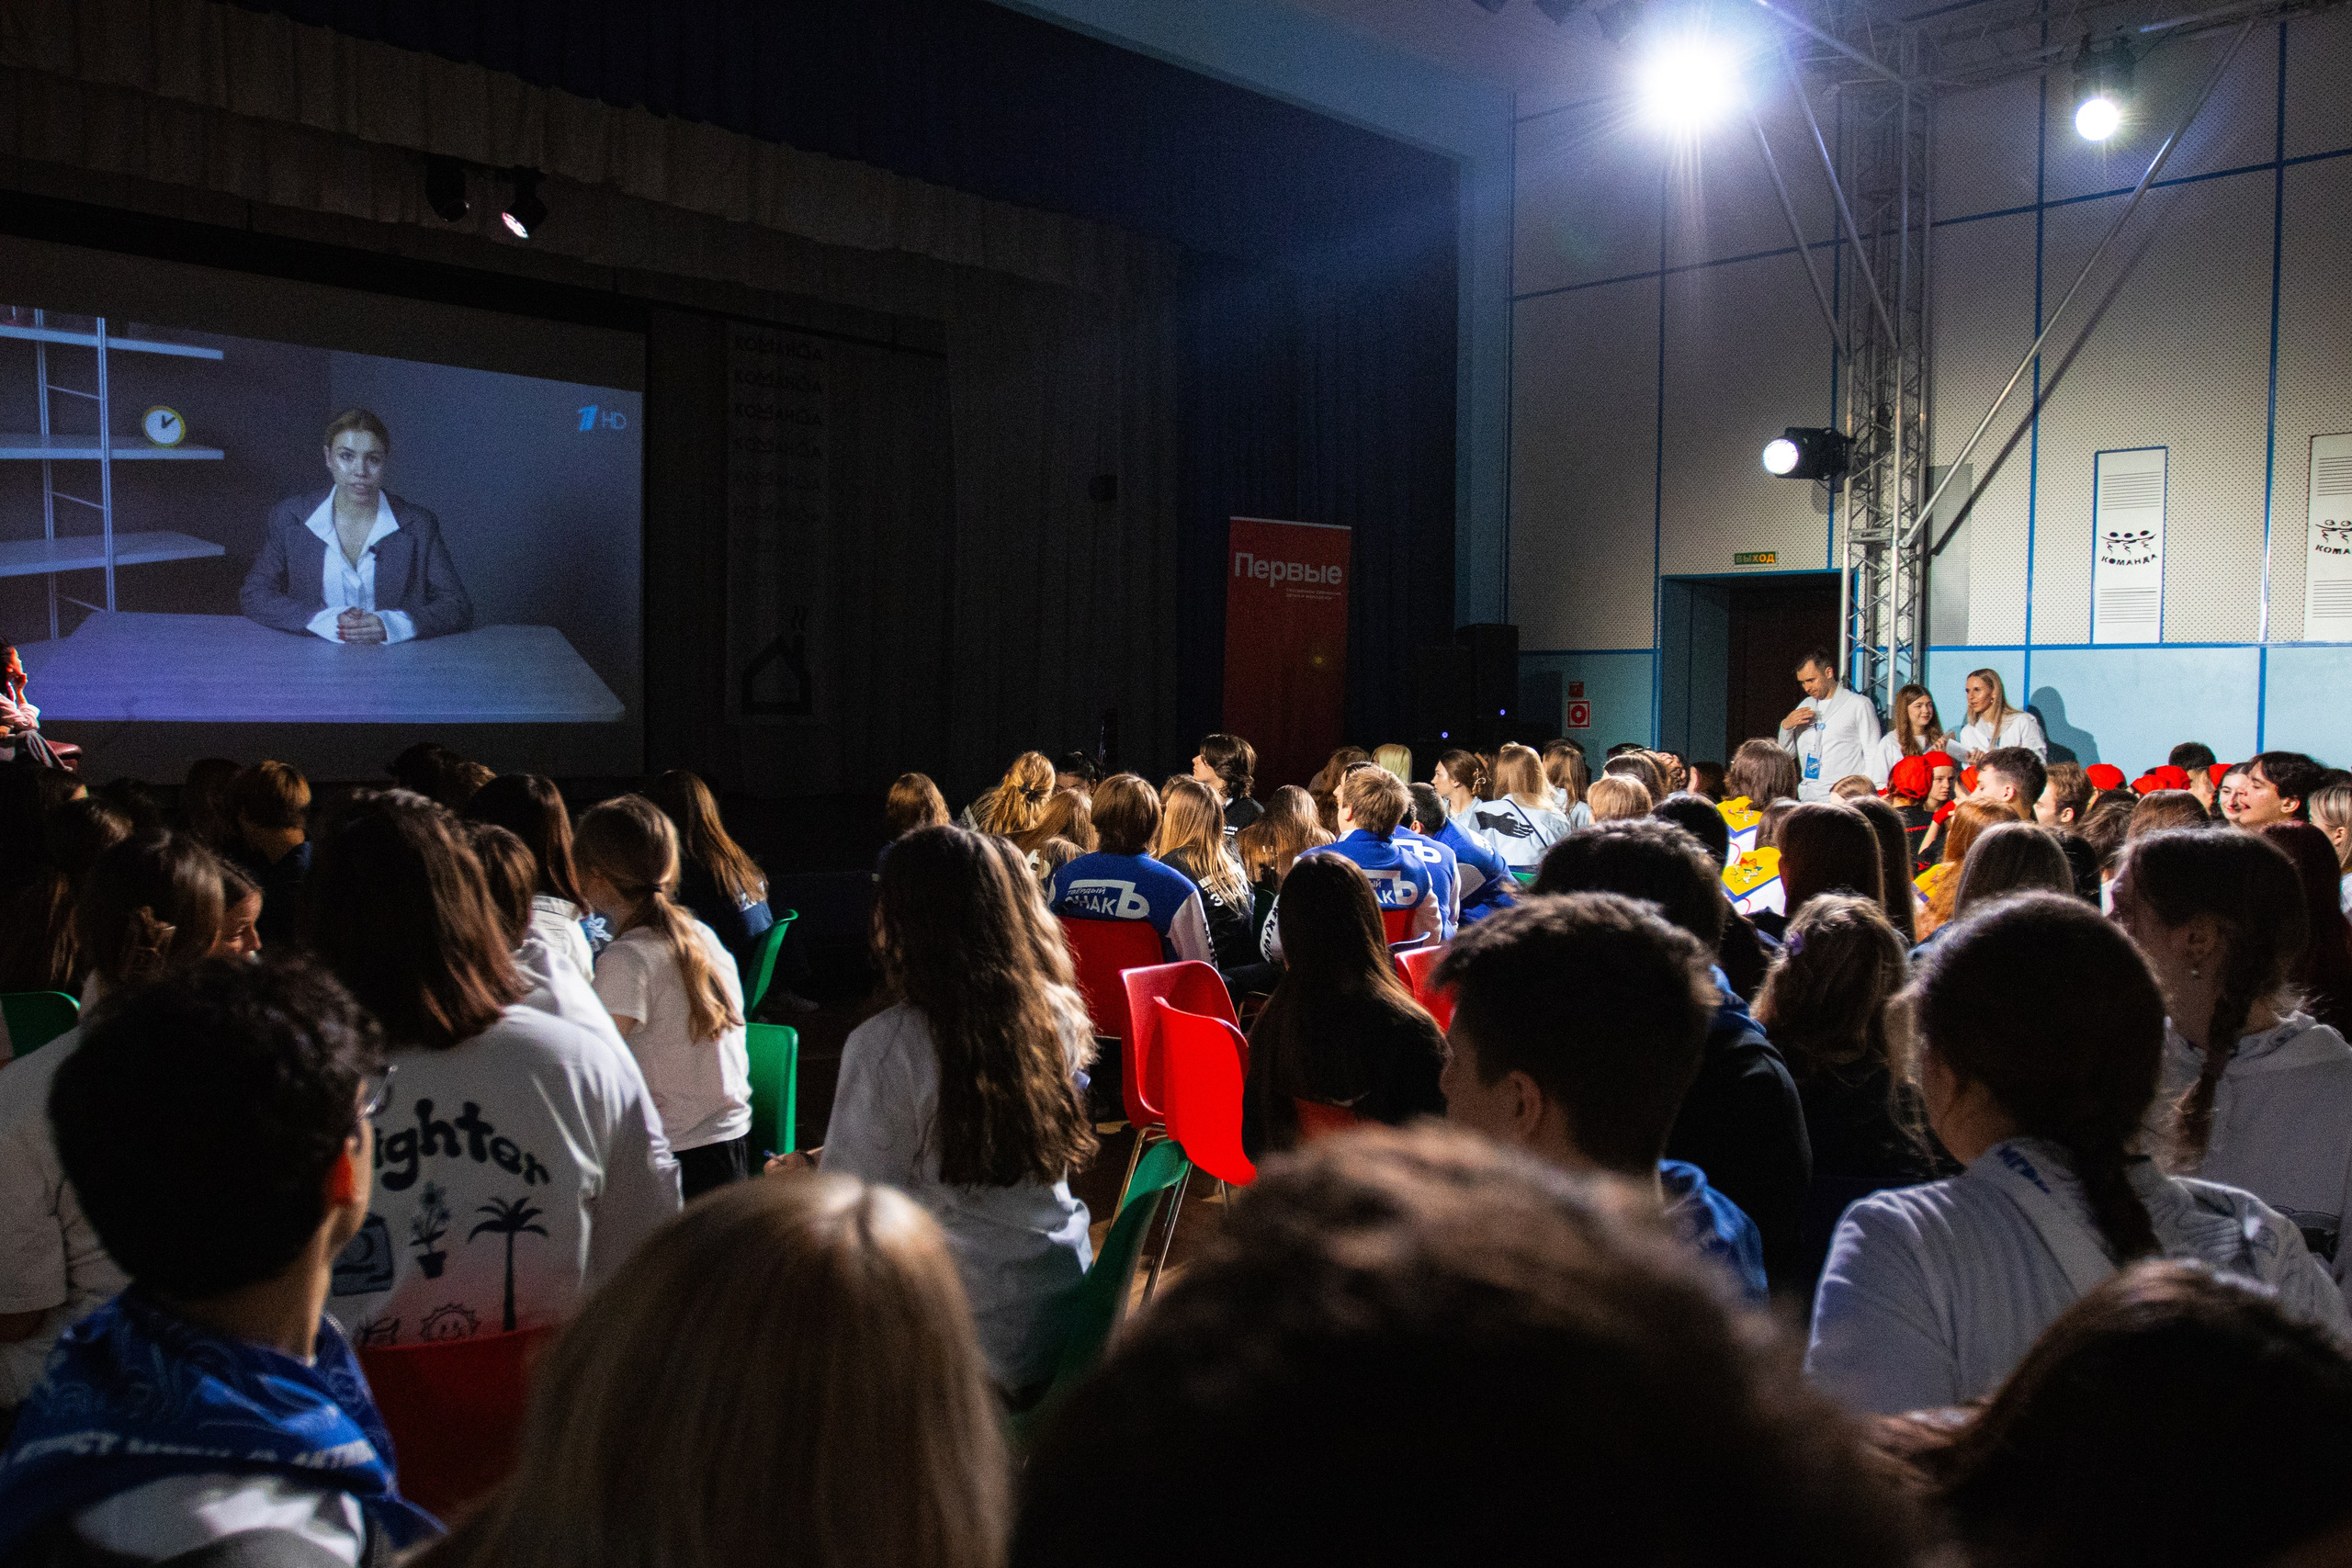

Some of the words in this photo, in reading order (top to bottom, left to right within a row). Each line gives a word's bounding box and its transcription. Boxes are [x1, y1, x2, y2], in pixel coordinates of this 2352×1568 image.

[602, 411, 628, 431] HD
[1736, 554, 1775, 564] ВЫХОД
[2101, 554, 2158, 566] КОМАНДА
[1234, 552, 1342, 588] Первые
